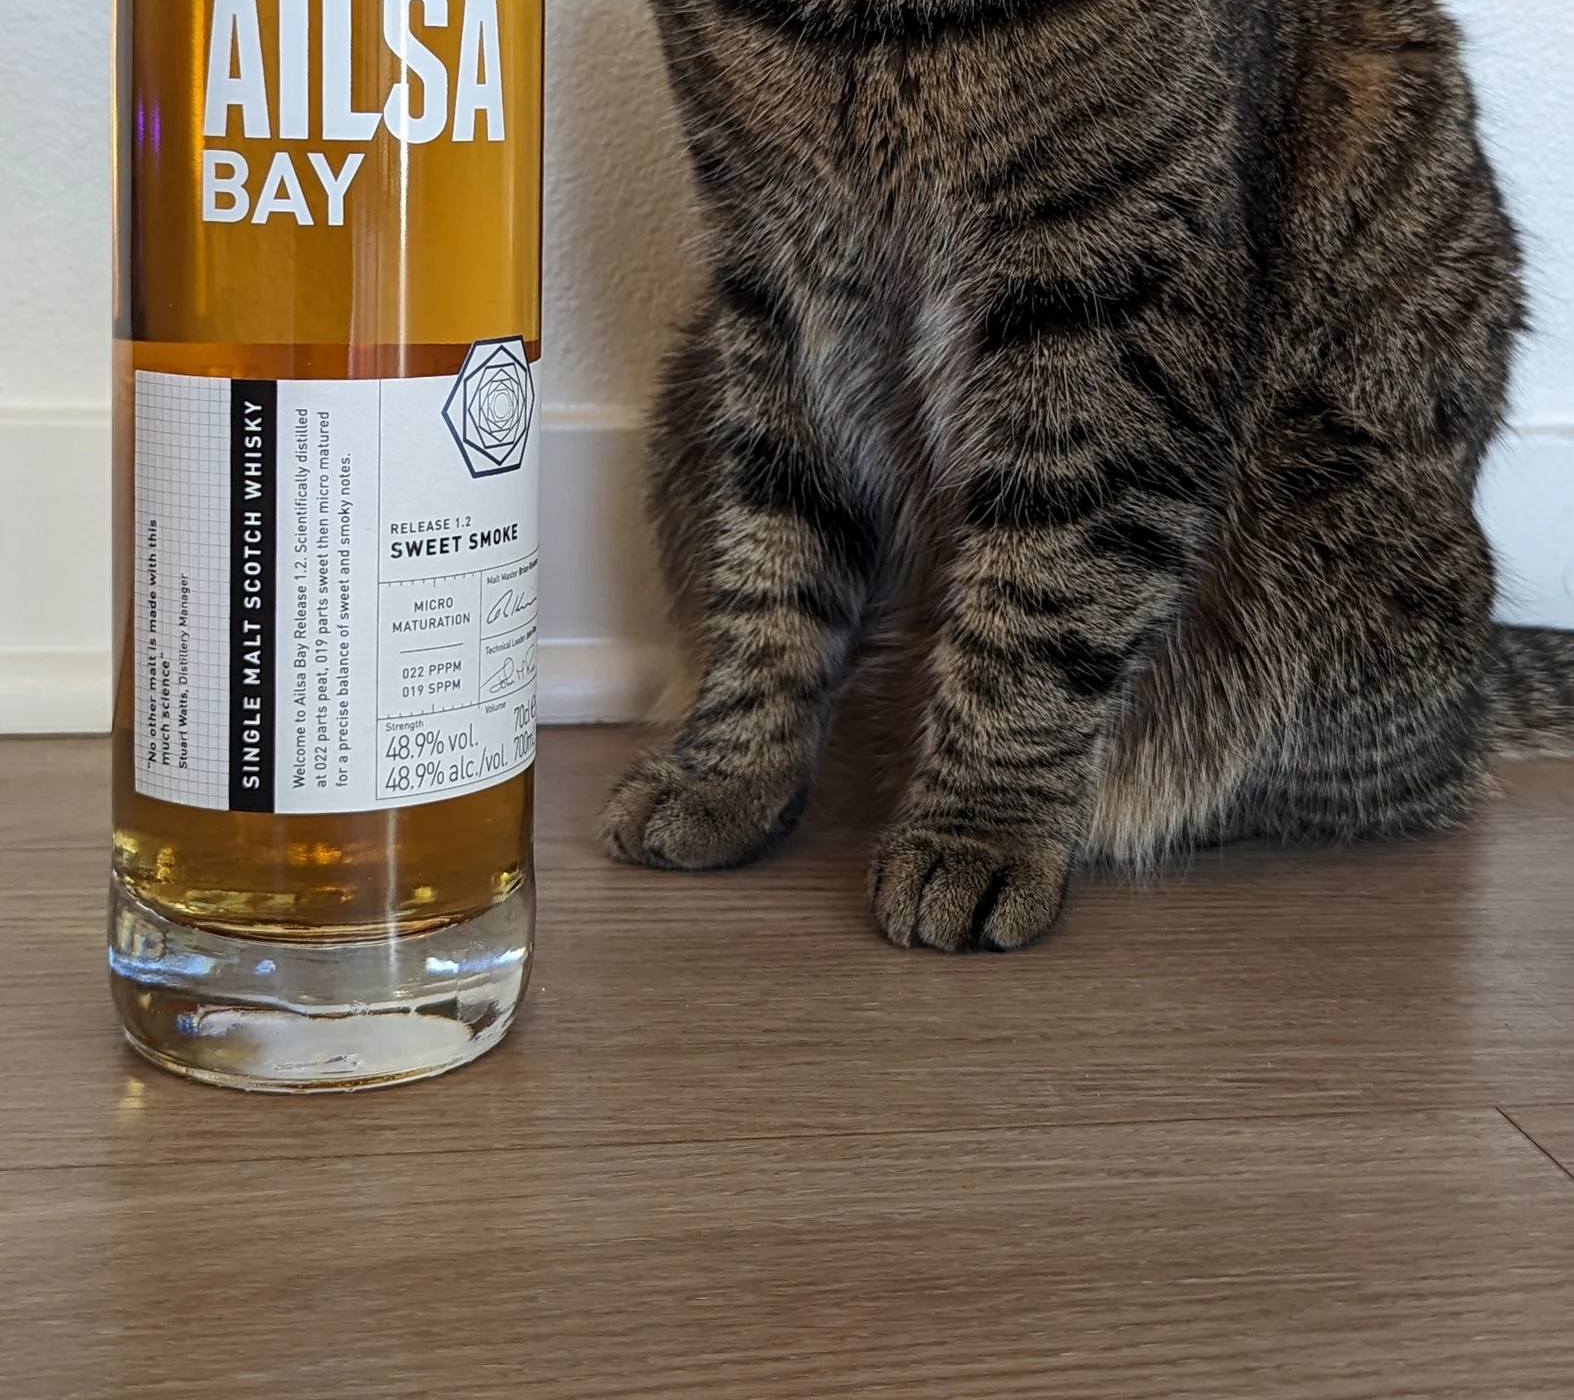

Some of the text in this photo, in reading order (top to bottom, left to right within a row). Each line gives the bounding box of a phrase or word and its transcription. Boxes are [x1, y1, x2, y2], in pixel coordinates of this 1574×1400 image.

[203, 149, 366, 226] BAY
[148, 519, 157, 548] this
[390, 515, 472, 535] RELEASE 1.2
[390, 523, 519, 560] SWEET SMOKE
[148, 553, 157, 586] with
[148, 590, 157, 633] made
[242, 400, 262, 789] SINGLE MALT SCOTCH WHISKY
[293, 408, 311, 789] Welcome to Ailsa Bay Release 1.2. Scientifically distilled
[314, 411, 331, 788] at 022 parts peat, 019 parts sweet then micro matured
[413, 596, 454, 613] MICRO
[336, 452, 353, 787] for a precise balance of sweet and smoky notes.
[392, 612, 471, 633] MATURATION
[148, 638, 157, 651] is
[485, 639, 511, 655] Technical
[148, 654, 157, 691] malt
[179, 573, 191, 769] Stuart Watts, Distillery Manager
[402, 660, 462, 680] 022 PPPM
[402, 679, 461, 698] 019 SPPM
[148, 695, 157, 737] other
[484, 700, 507, 714] Volume
[160, 724, 170, 765] much
[385, 719, 424, 733] Strength
[385, 723, 479, 761] 48.9% vol.
[385, 743, 508, 792] 48.9% alc./vol.
